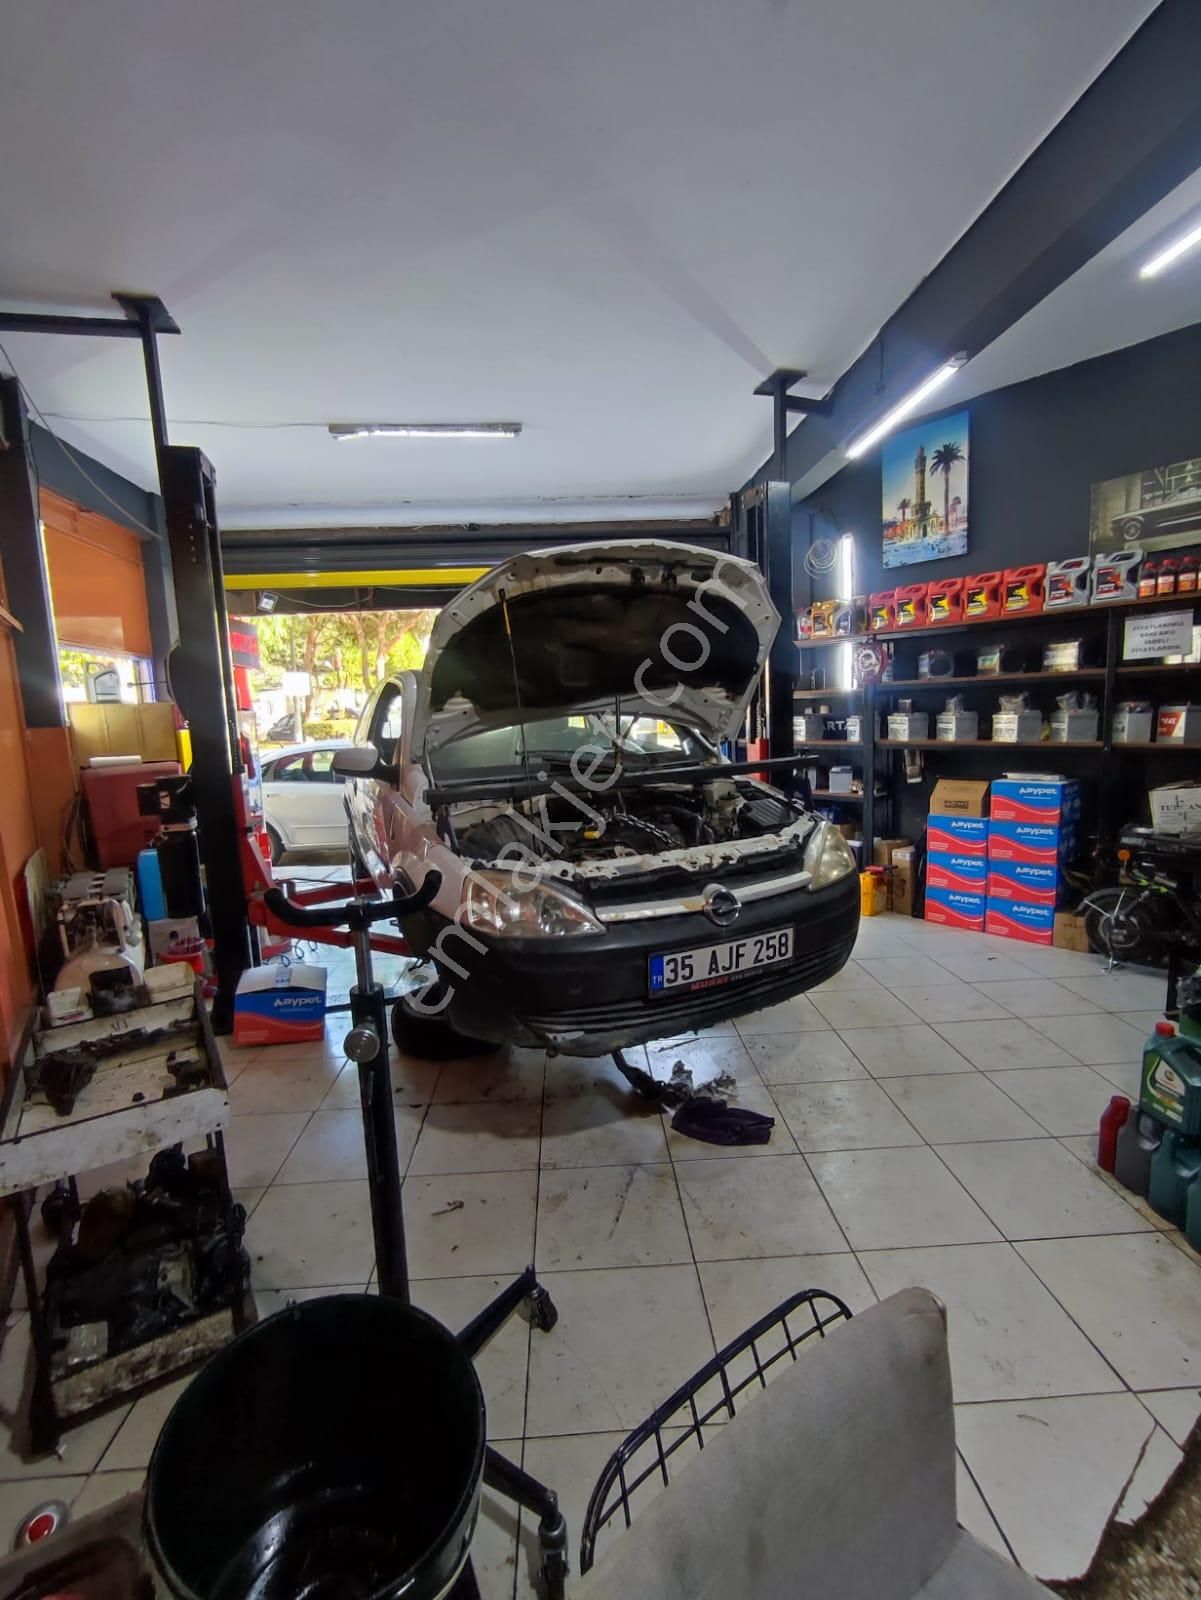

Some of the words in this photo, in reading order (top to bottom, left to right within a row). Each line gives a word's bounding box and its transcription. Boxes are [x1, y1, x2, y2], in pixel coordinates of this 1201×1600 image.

[665, 954, 694, 985] 35
[707, 942, 747, 976] AJF
[753, 932, 789, 965] 258
[651, 974, 663, 985] TR
